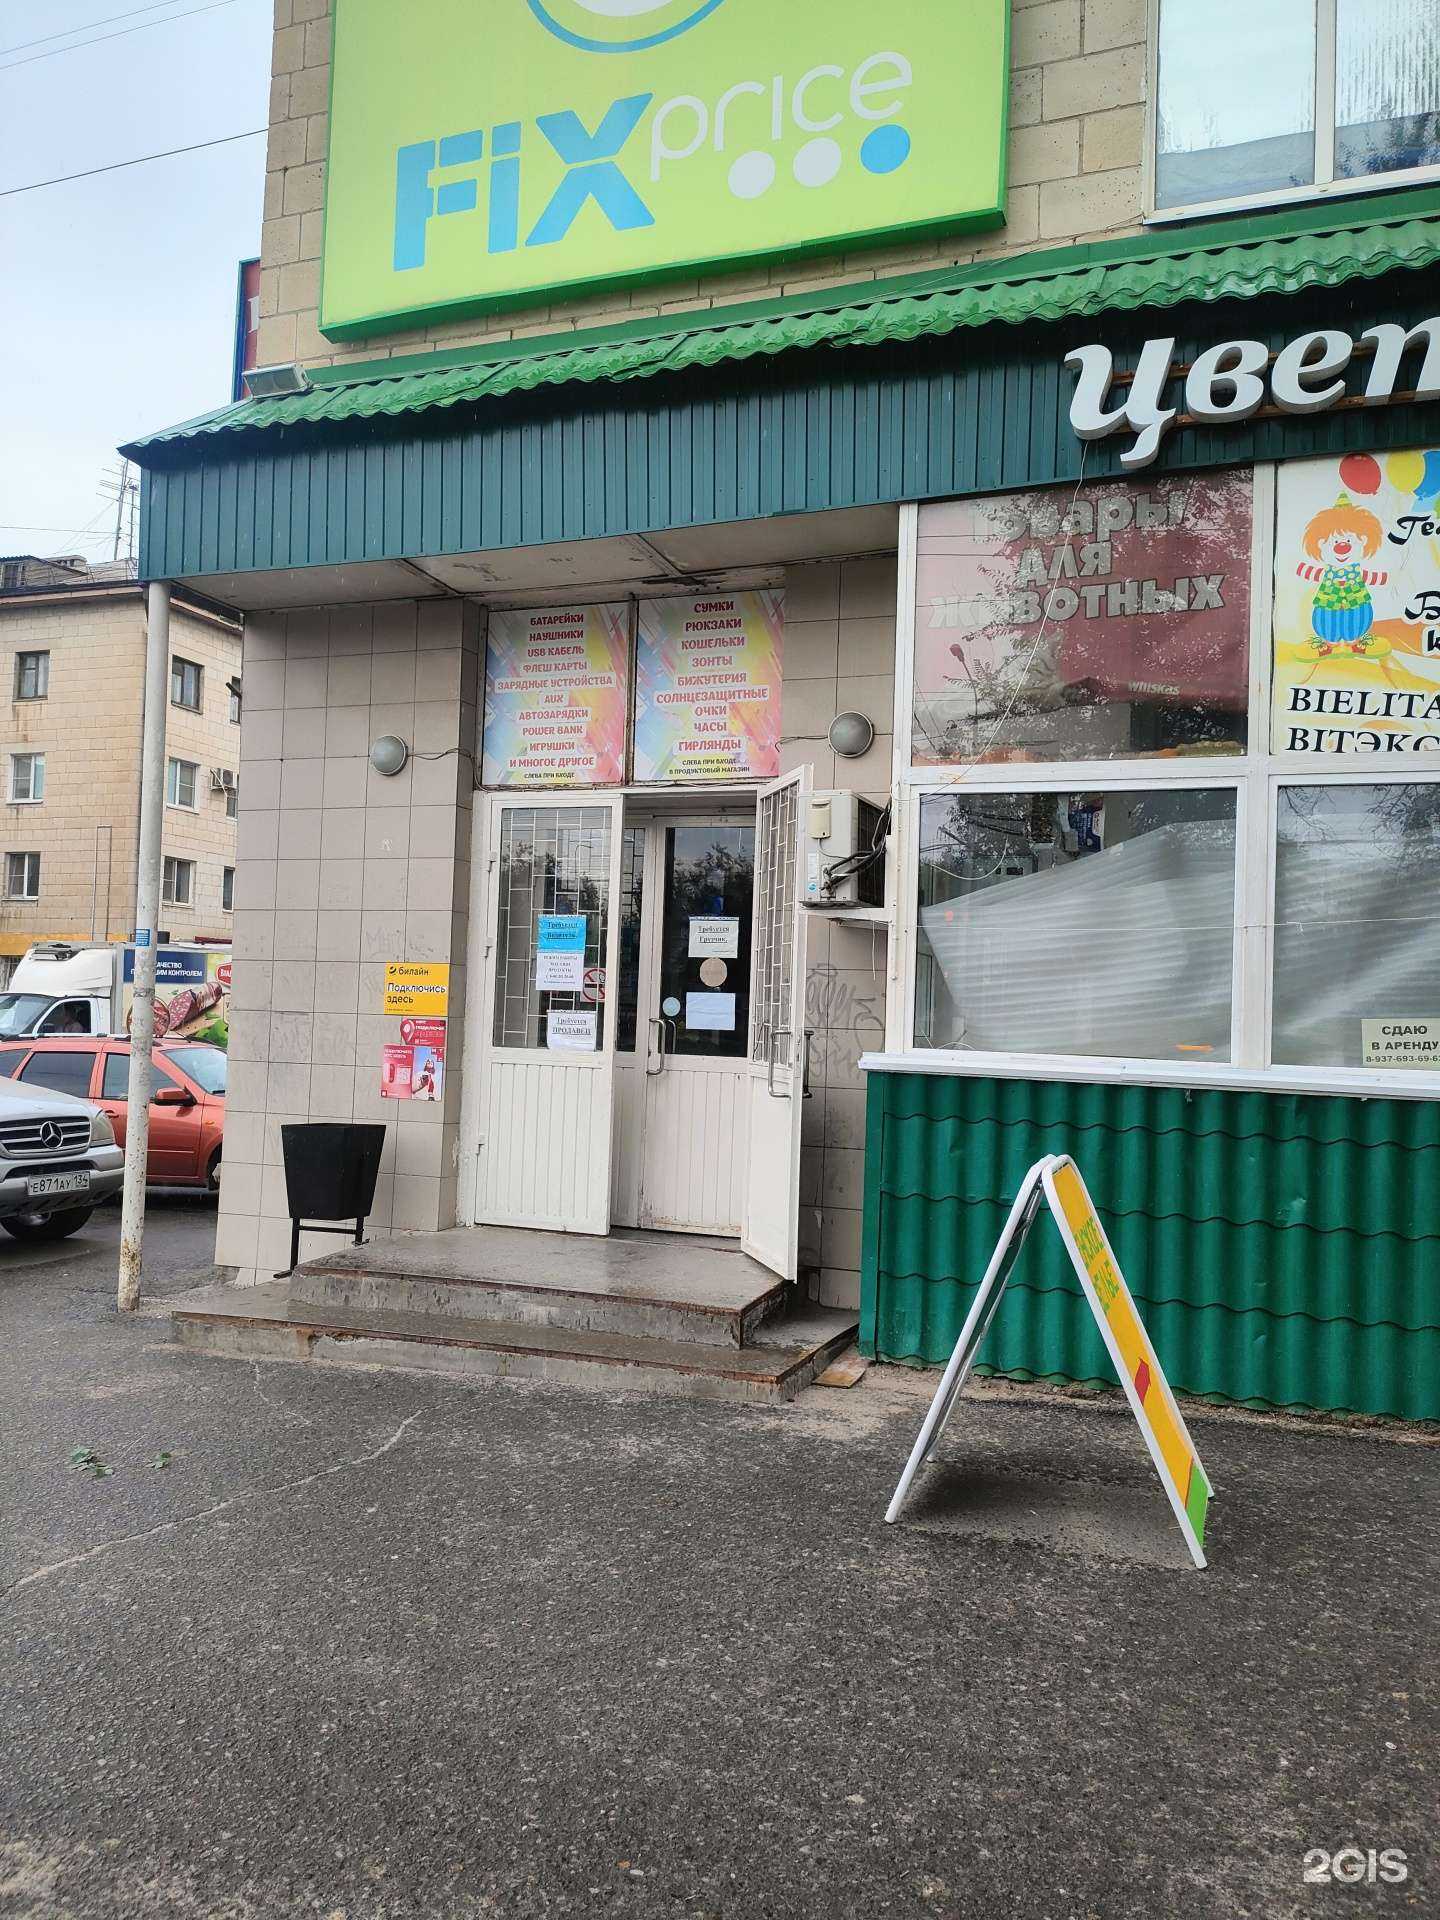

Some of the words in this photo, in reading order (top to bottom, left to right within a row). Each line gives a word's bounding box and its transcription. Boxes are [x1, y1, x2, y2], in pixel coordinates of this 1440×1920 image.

[651, 51, 913, 181] price
[1387, 514, 1440, 546] Ге
[694, 600, 734, 613] СУМКИ
[530, 612, 584, 626] БАТАРЕЙКИ
[685, 618, 742, 632] РЮКЗАКИ
[529, 630, 584, 642] НАУШНИКИ
[681, 636, 745, 650] КОШЕЛЬКИ
[527, 648, 546, 658] USB
[548, 646, 584, 656] КАБЕЛЬ
[522, 663, 553, 673] ФЛЕШ
[554, 661, 587, 671] КАРТЫ
[692, 656, 733, 667] ЗОНТЫ
[498, 680, 550, 690] ЗАРЯДНЫЕ
[551, 675, 612, 688] УСТРОЙСТВА
[677, 672, 747, 686] БИЖУТЕРИЯ
[543, 694, 564, 704] AUX
[656, 688, 768, 704] СОЛНЦЕЗАЩИТНЫЕ
[518, 710, 588, 721] АВТОЗАРЯДКИ
[695, 705, 727, 716] ОЧКИ
[522, 727, 556, 736] POWER
[557, 725, 584, 734] BANK
[694, 722, 727, 732] ЧАСЫ
[529, 741, 575, 752] ИГРУШКИ
[678, 739, 741, 752] ГИРЛЯНДЫ
[509, 759, 517, 767] И
[518, 758, 557, 767] МНОГОЕ
[558, 756, 594, 767] ДРУГОЕ
[674, 766, 721, 775] ПРОДУКТОВЫЙ
[156, 961, 183, 969] АЧЕСТВО
[398, 966, 429, 976] билайн
[387, 982, 446, 994] Подключись
[386, 994, 414, 1004] здесь
[1381, 1025, 1428, 1037] СДАЮ
[1371, 1042, 1380, 1050] В
[1385, 1041, 1439, 1051] АРЕНДУ
